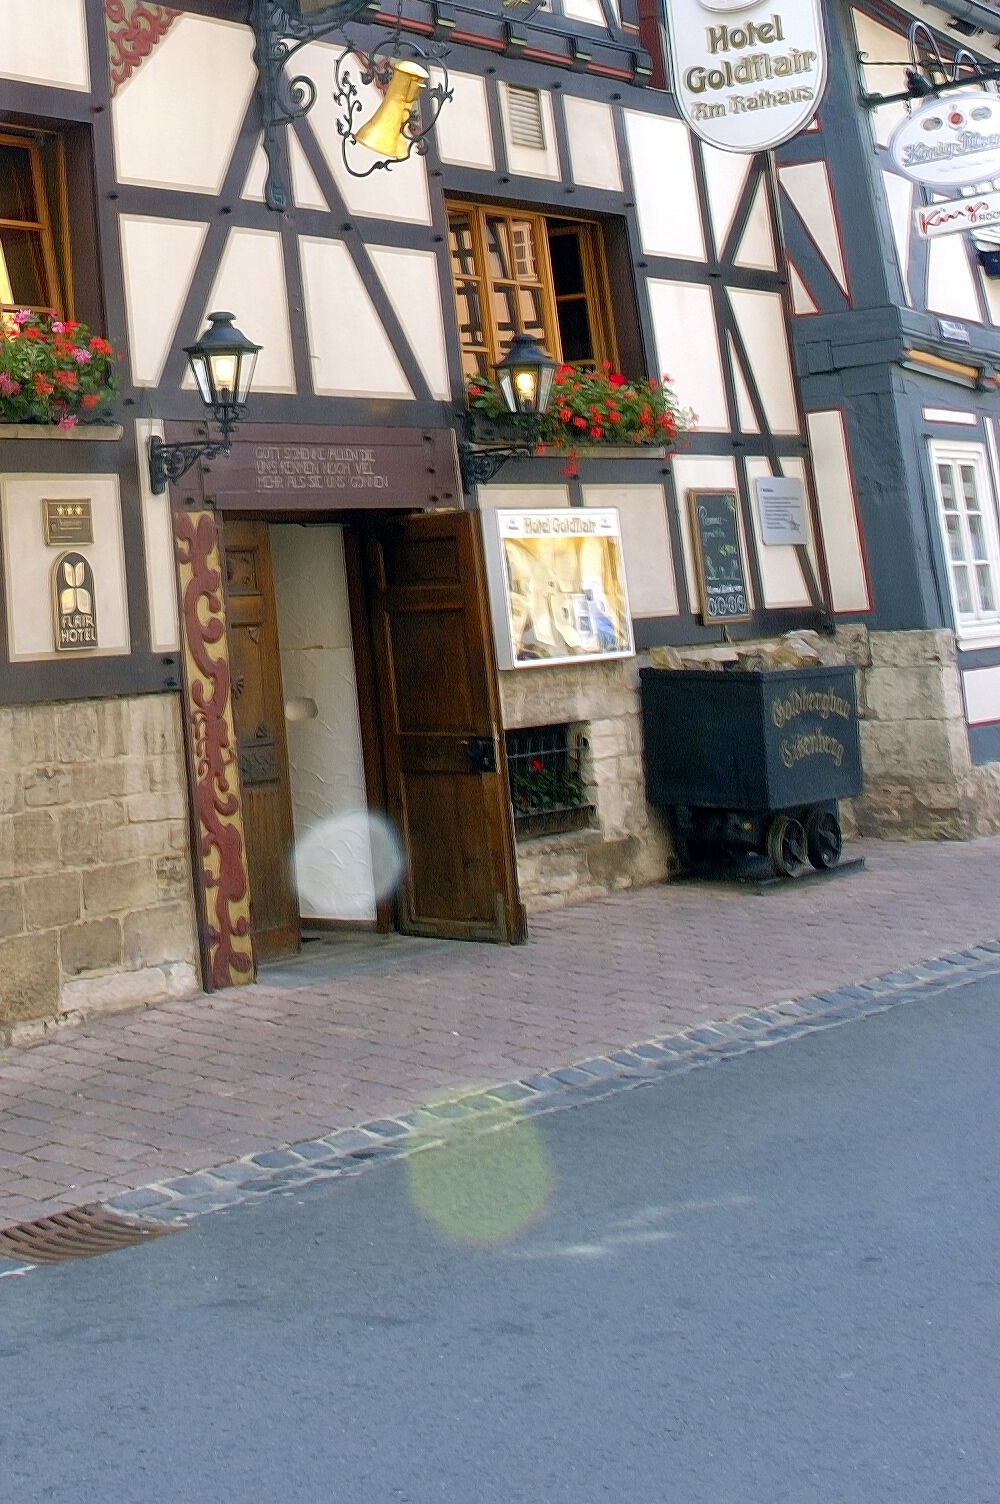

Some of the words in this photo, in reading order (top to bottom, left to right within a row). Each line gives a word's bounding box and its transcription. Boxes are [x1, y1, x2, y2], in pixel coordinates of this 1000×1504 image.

[706, 13, 784, 54] Hotel
[685, 48, 817, 94] Goldflair
[692, 102, 726, 121] Am
[729, 87, 814, 114] Rathaus
[60, 628, 97, 643] HOTEL
[61, 614, 95, 629] FLAIR
